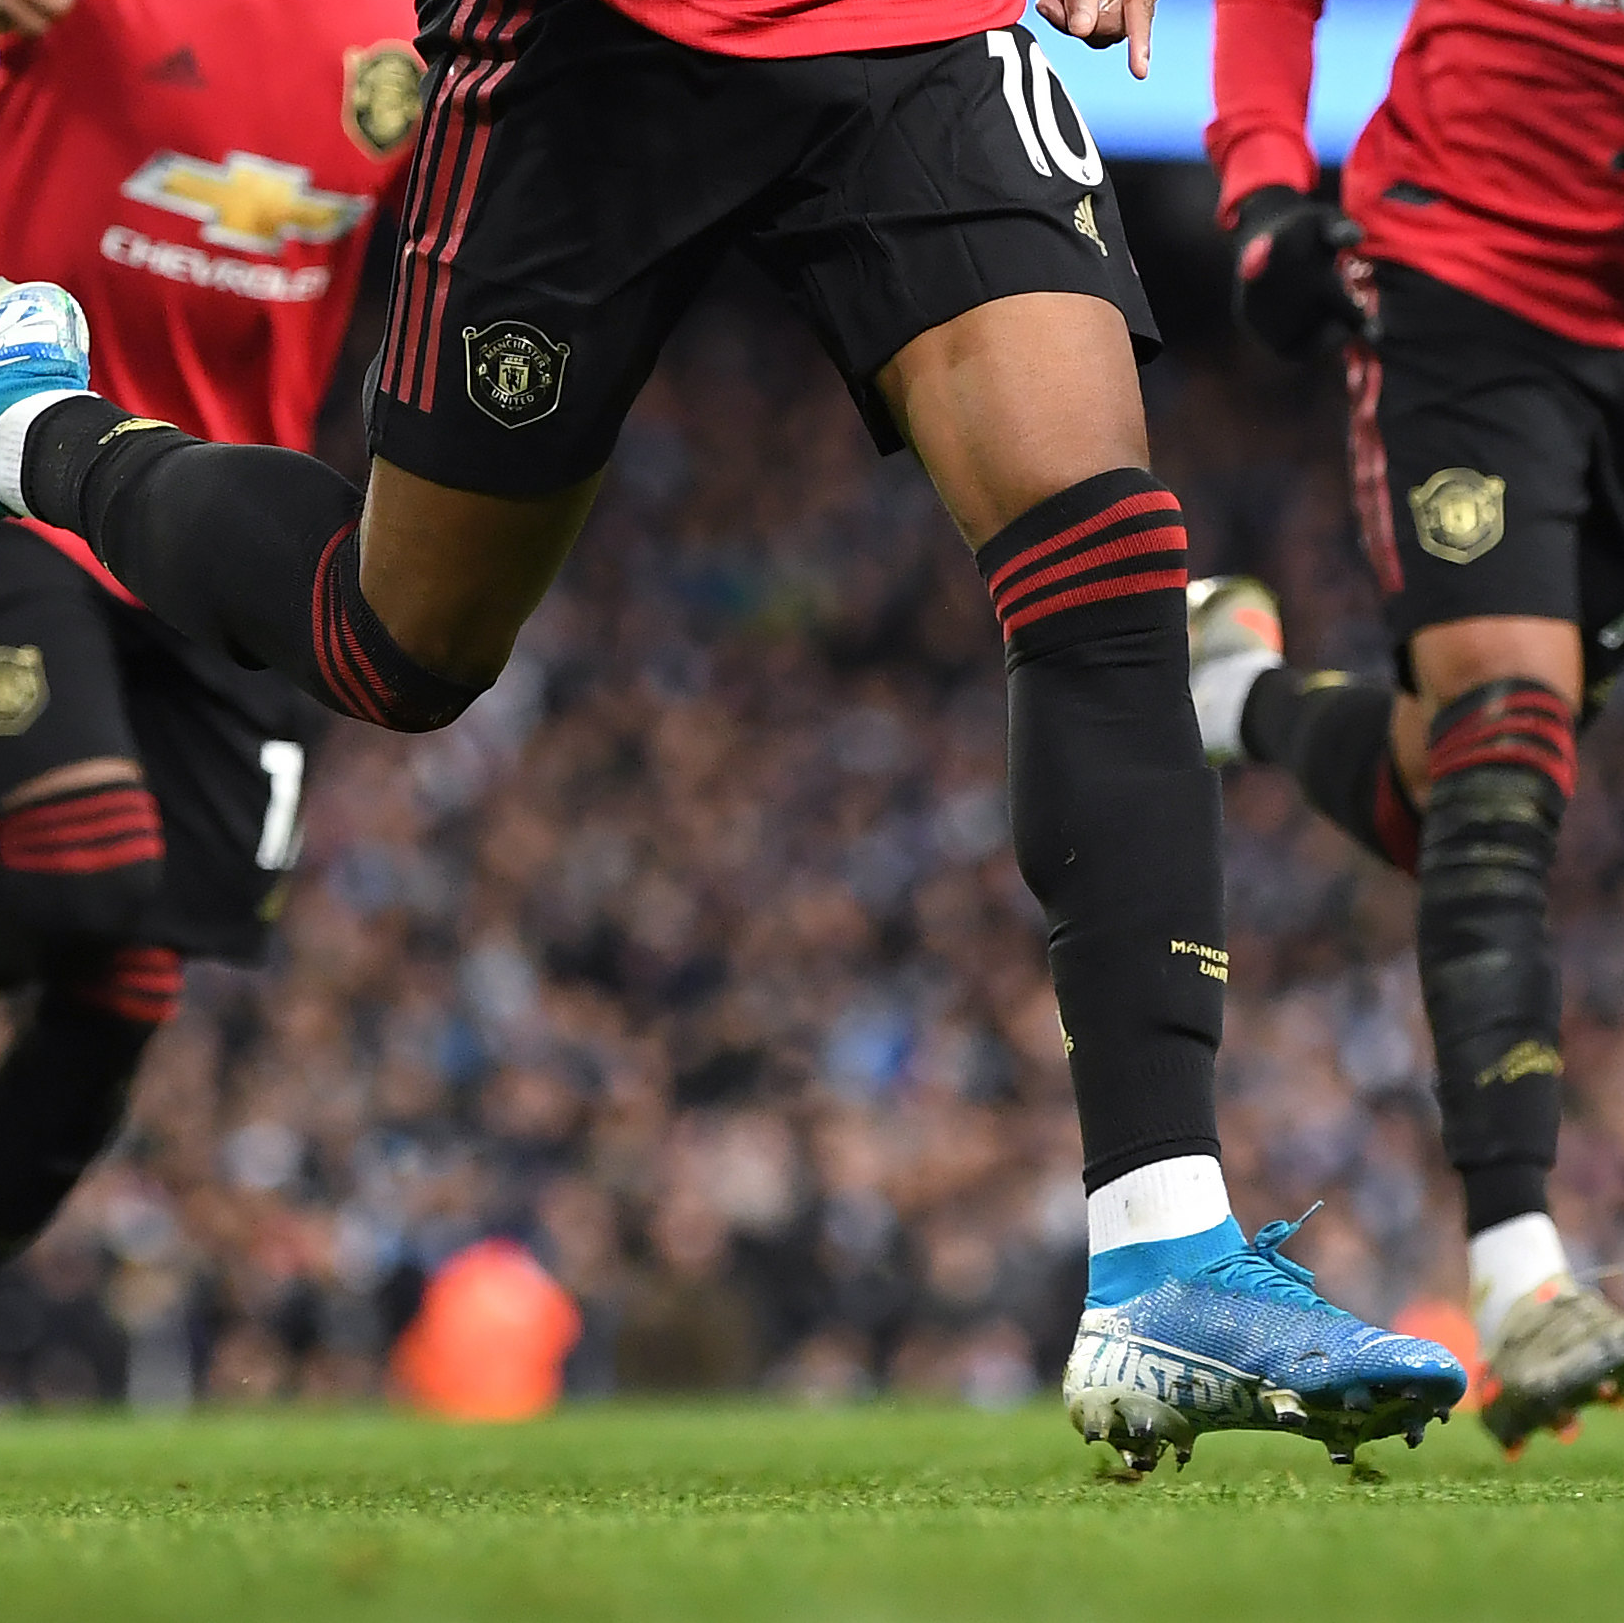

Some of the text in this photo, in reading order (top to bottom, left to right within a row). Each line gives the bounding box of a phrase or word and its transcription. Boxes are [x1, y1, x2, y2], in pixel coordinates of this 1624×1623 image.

[985, 30, 1105, 187] 10
[484, 339, 547, 370] MANCHESTER
[490, 388, 535, 406] UNITED
[254, 739, 306, 871] 1
